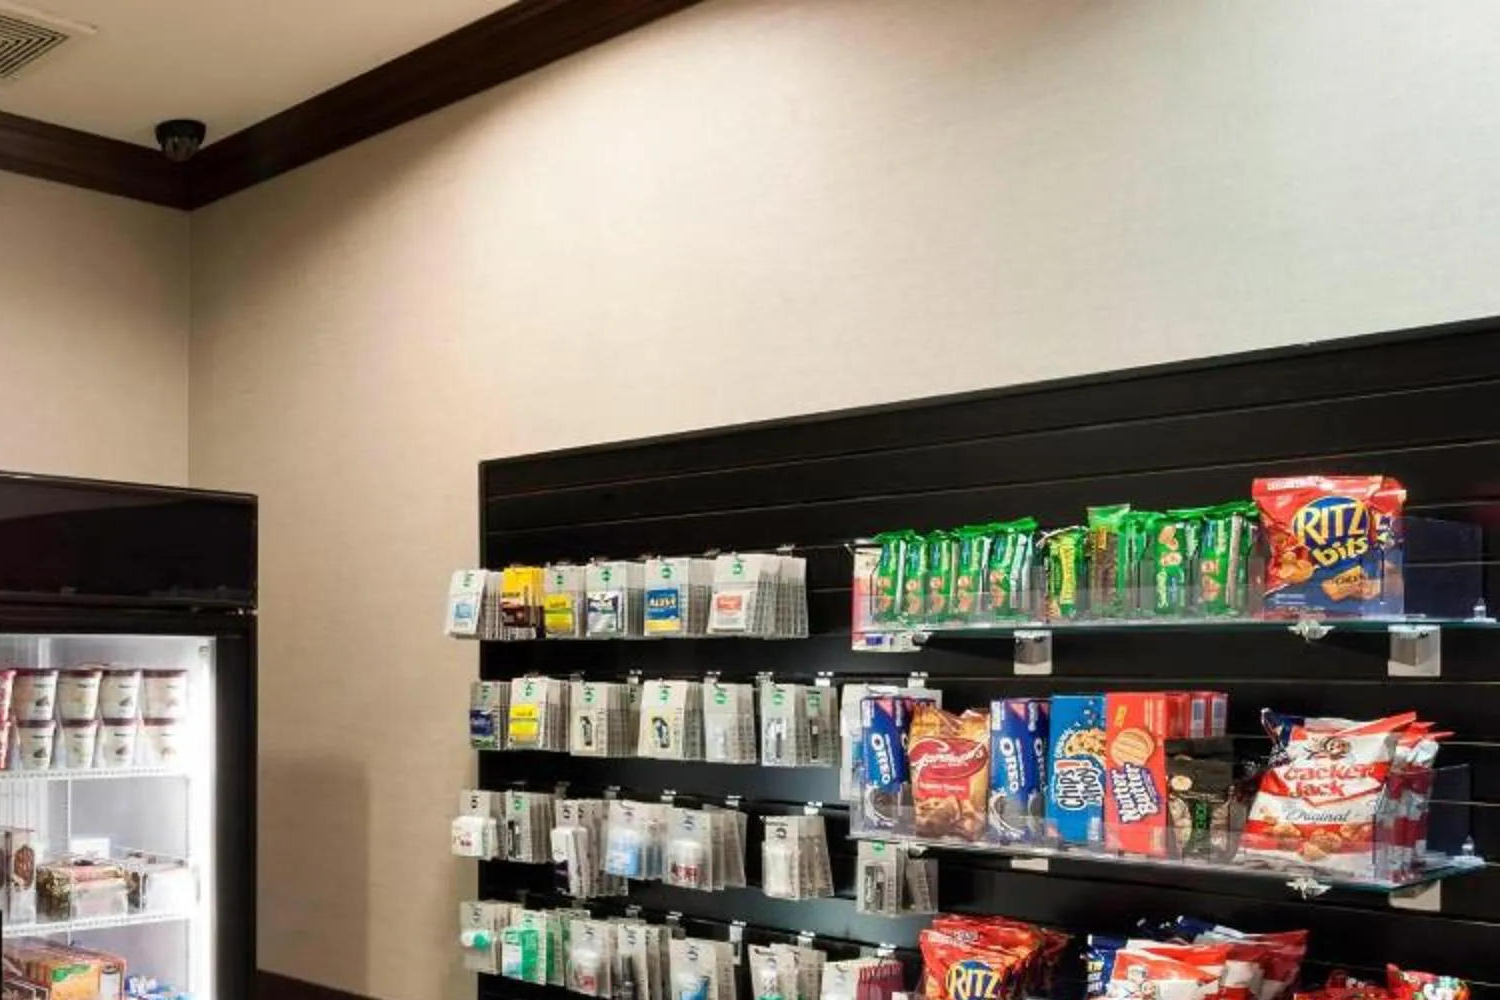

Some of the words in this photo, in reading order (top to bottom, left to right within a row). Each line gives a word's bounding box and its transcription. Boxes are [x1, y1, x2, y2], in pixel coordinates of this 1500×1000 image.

[1297, 502, 1366, 545] RITZ
[1312, 537, 1368, 566] bits
[871, 733, 891, 785] OREO
[1000, 738, 1019, 793] OREO
[1112, 769, 1141, 821] Nutter
[1125, 763, 1159, 814] Butter
[1288, 781, 1346, 798] Jack
[949, 964, 1000, 1000] RITZ
